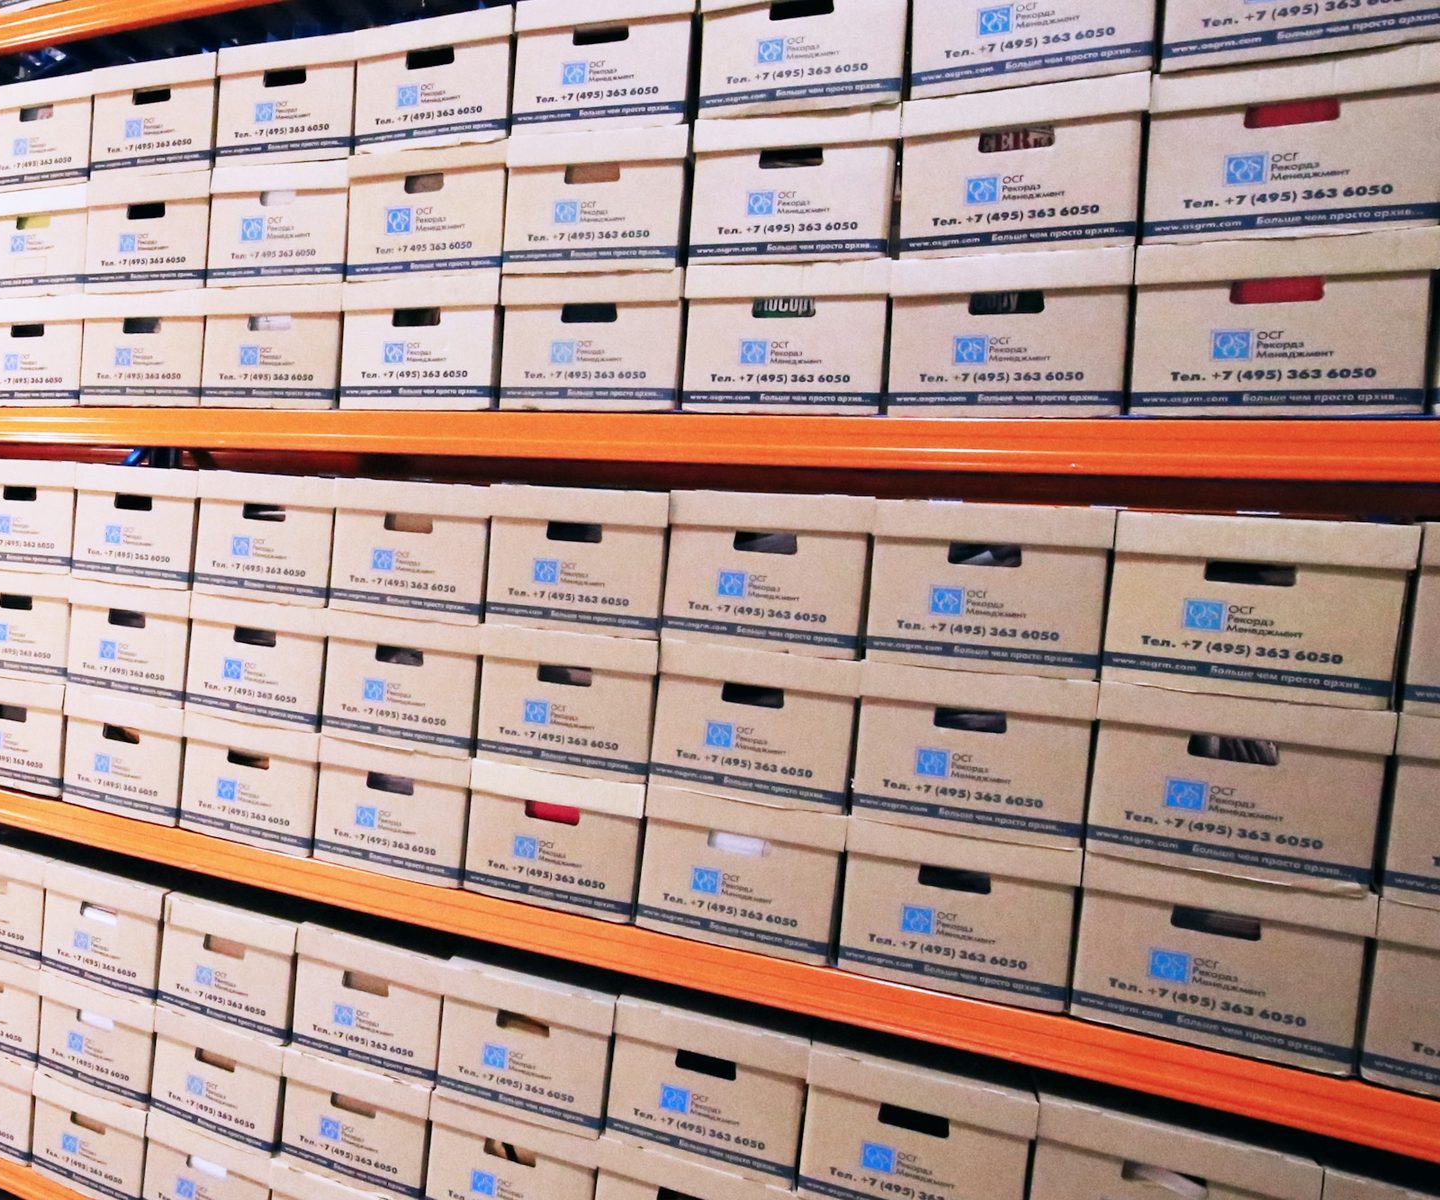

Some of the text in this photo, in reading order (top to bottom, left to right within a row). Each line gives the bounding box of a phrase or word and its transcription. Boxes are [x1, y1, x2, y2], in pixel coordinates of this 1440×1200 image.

[943, 25, 1115, 58] Тел. +7 (495) 363 6050
[535, 85, 659, 103] Тел. +7 (495) 363 6050
[396, 113, 408, 122] +7
[409, 110, 434, 122] (495)
[436, 108, 455, 118] 363
[456, 104, 482, 115] 6050
[1271, 151, 1299, 162] ОСГ
[1002, 174, 1024, 184] ОСГ
[1183, 183, 1393, 208] Тел. +7 (495) 363 6050
[931, 203, 1100, 226] Тел. +7 (495) 363 6050
[1329, 210, 1371, 222] просто
[527, 229, 650, 242] Тел. +7 (495) 363 6050
[989, 336, 1011, 345] ОСГ
[1256, 330, 1284, 340] ОСГ
[382, 370, 394, 378] +7
[395, 370, 420, 380] (495)
[421, 370, 440, 378] 363
[442, 370, 468, 378] 6050
[710, 373, 850, 384] Тел. +7 (495) 363 6050
[919, 371, 1084, 384] Тел. +7 (495) 363 6050
[1169, 367, 1376, 382] Тел. +7 (495) 363 6050
[1313, 393, 1354, 403] просто
[1228, 604, 1255, 615] ОСГ
[897, 620, 1060, 642] Тел. +7 (495) 363 6050
[1141, 635, 1344, 665] Тел. +7 (495) 363 6050
[1279, 674, 1320, 685] просто
[499, 726, 619, 751] Тел. +7 (495) 363 6050
[882, 779, 1044, 809] Тел. +7 (495) 363 6050
[1209, 785, 1236, 797] ОСГ
[1124, 810, 1324, 851] Тел. +7 (495) 363 6050
[487, 859, 605, 891] Тел. +7 (495) 363 6050
[869, 933, 1028, 971] Тел. +7 (495) 363 6050
[1219, 999, 1254, 1017] 363
[1258, 1008, 1307, 1028] 6050
[345, 1033, 368, 1047] (495)
[369, 1039, 387, 1051] 363
[389, 1044, 413, 1058] 6050
